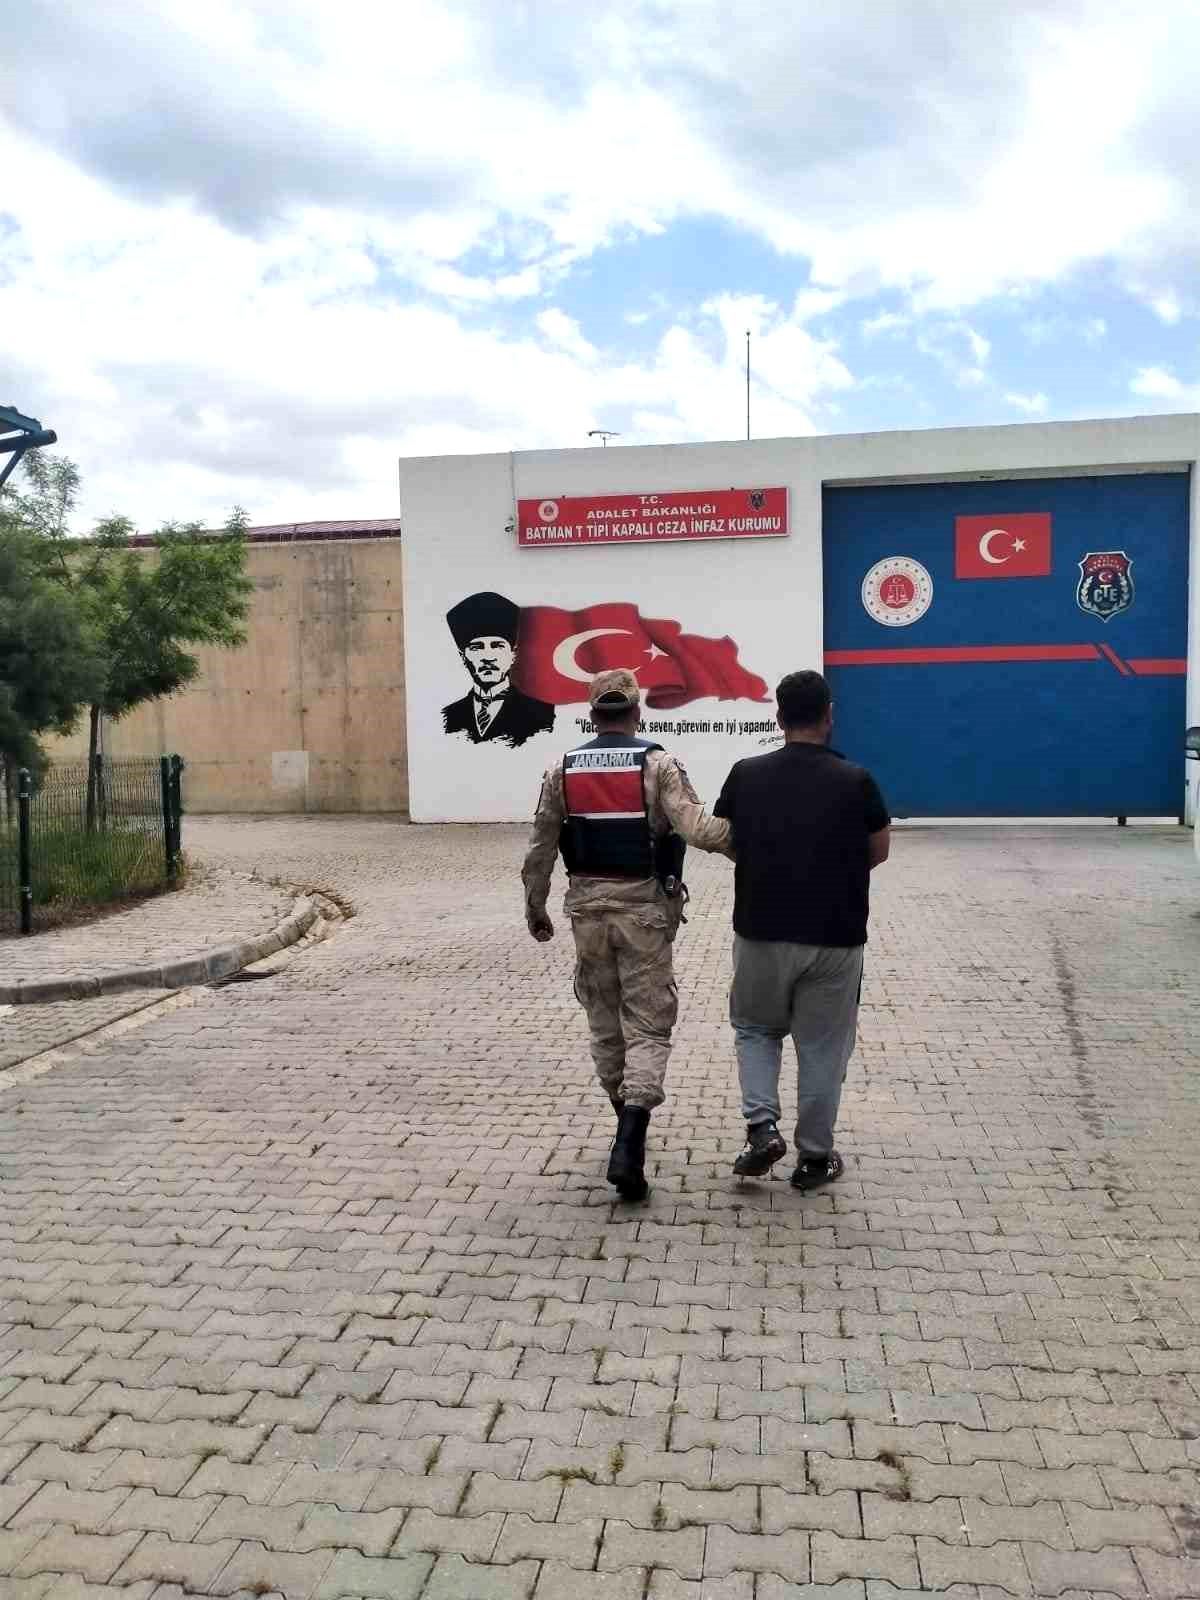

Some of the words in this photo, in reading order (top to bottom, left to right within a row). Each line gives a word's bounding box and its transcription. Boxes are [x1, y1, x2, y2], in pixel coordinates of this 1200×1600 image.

[639, 495, 663, 505] T.C.
[587, 509, 638, 519] ADALET
[642, 504, 717, 517] BAKANLIĞI
[526, 525, 573, 540] BATMAN
[576, 525, 583, 538] T
[612, 522, 653, 537] KAPALI
[656, 520, 687, 535] CEZA
[691, 517, 725, 533] İNFAZ
[729, 516, 781, 532] KURUMU
[1093, 584, 1119, 602] CTE
[713, 721, 724, 733] en
[726, 719, 737, 736] iyi
[571, 752, 635, 768] JANDARMA
